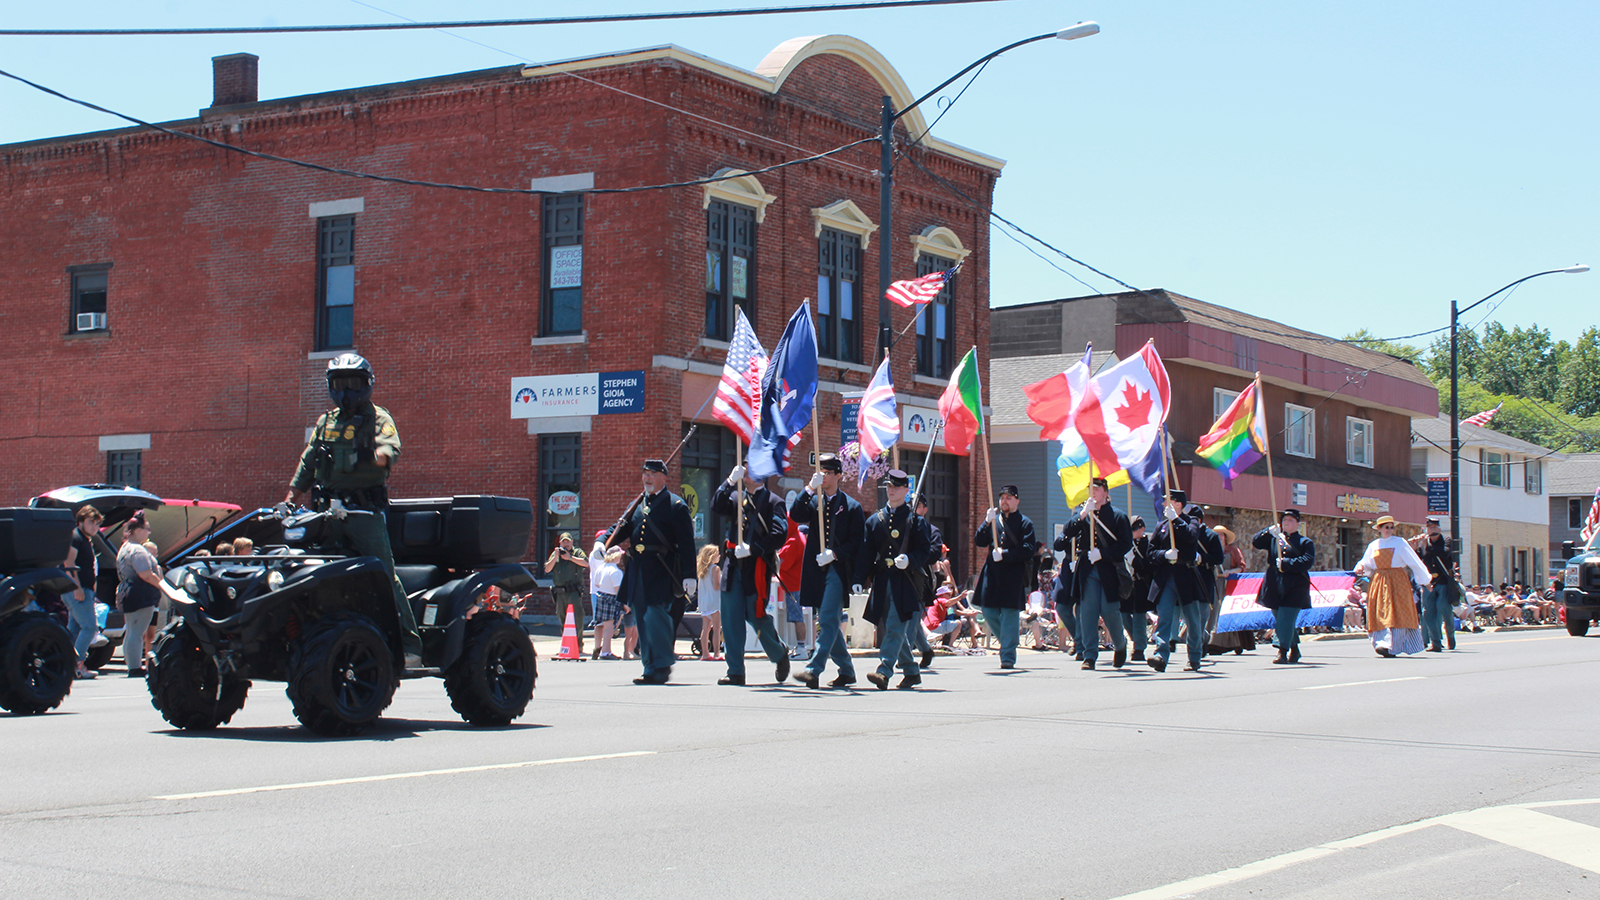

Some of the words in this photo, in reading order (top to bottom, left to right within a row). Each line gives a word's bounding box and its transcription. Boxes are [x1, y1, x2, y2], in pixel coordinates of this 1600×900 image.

[555, 249, 582, 259] OFFICE
[556, 258, 581, 268] SPACE
[603, 378, 637, 388] STEPHEN
[542, 386, 597, 397] FARMERS
[603, 389, 625, 398] GIOIA
[603, 398, 634, 408] AGENCY
[557, 503, 570, 511] SHOP
